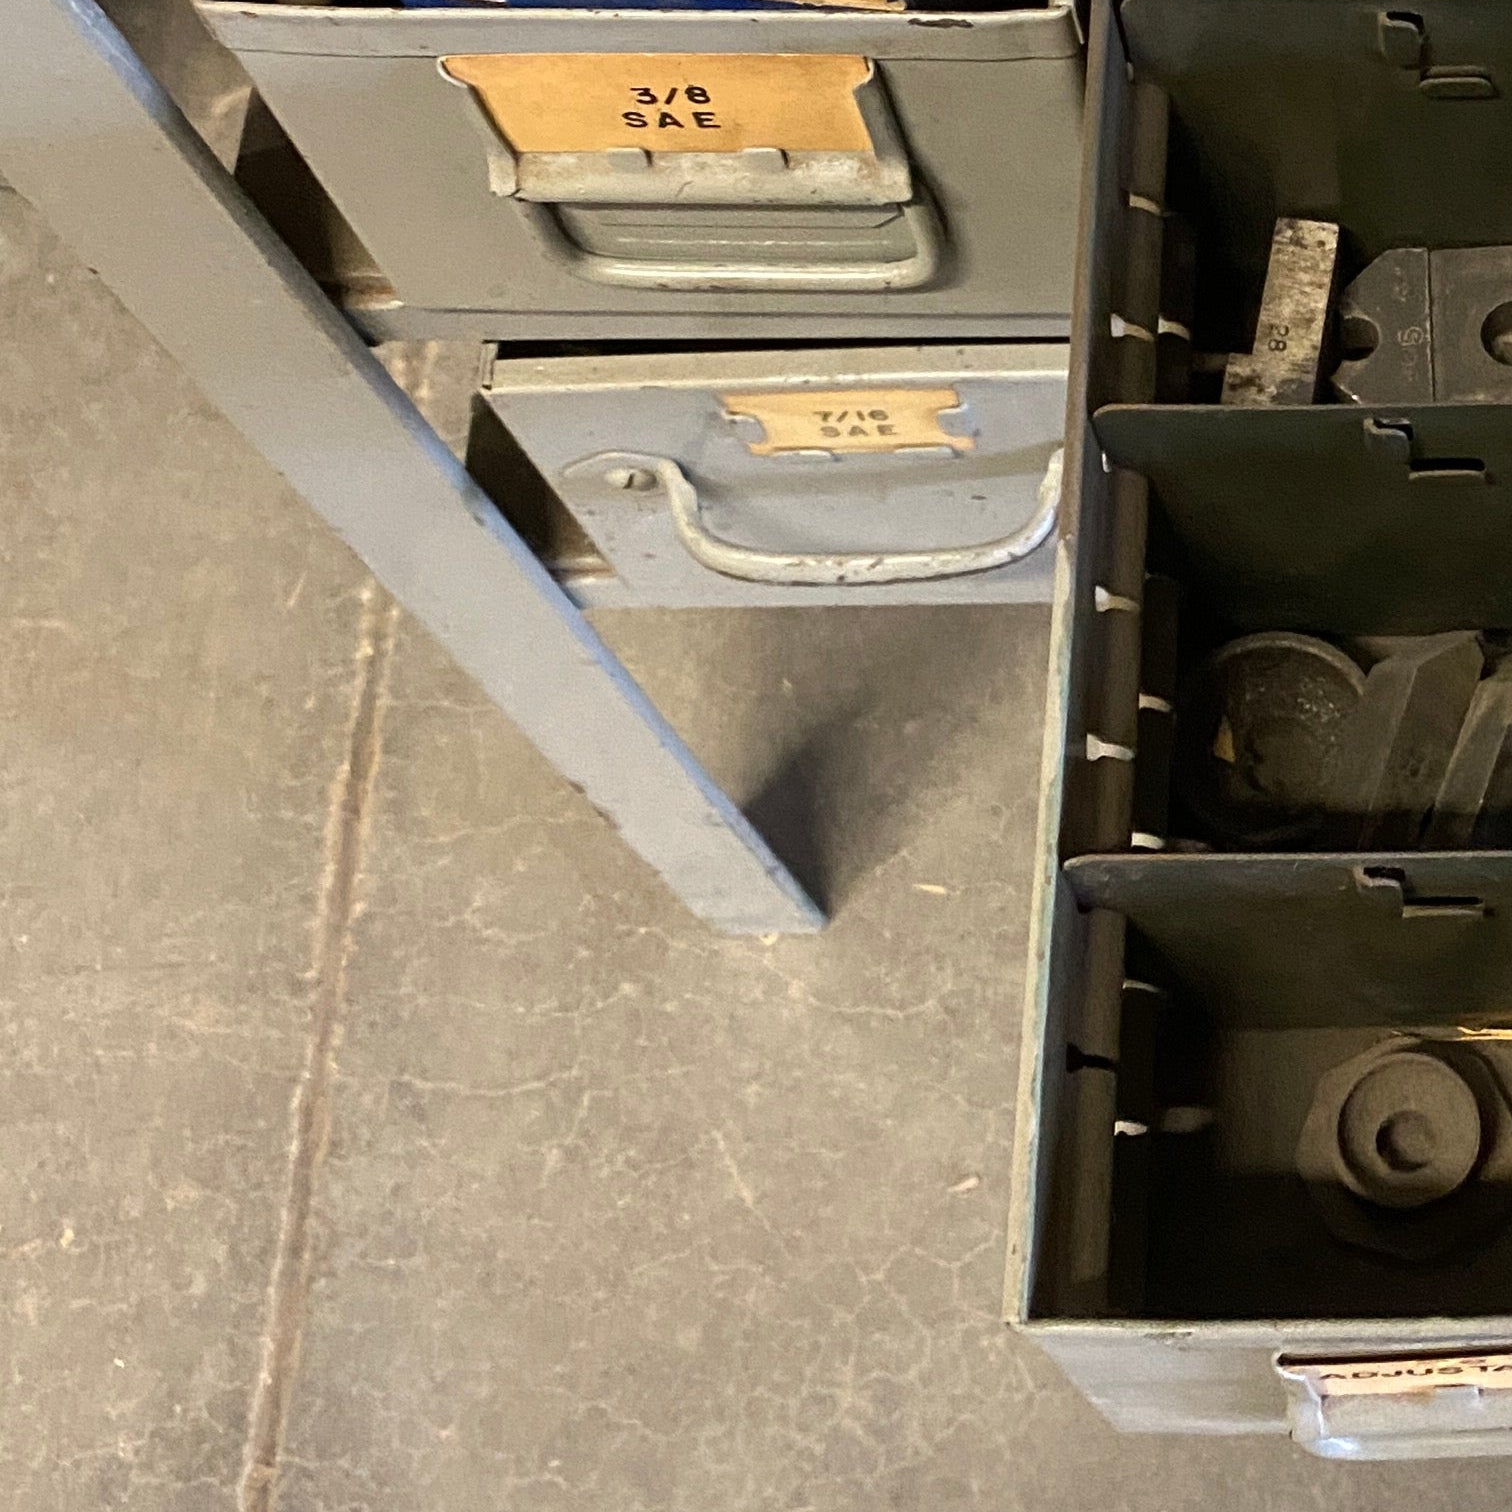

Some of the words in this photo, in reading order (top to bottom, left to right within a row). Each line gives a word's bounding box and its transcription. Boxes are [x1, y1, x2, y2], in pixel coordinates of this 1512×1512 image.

[629, 86, 711, 106] 3/8
[621, 110, 722, 130] SAE
[812, 409, 890, 424] 7/16
[819, 424, 898, 439] SAE
